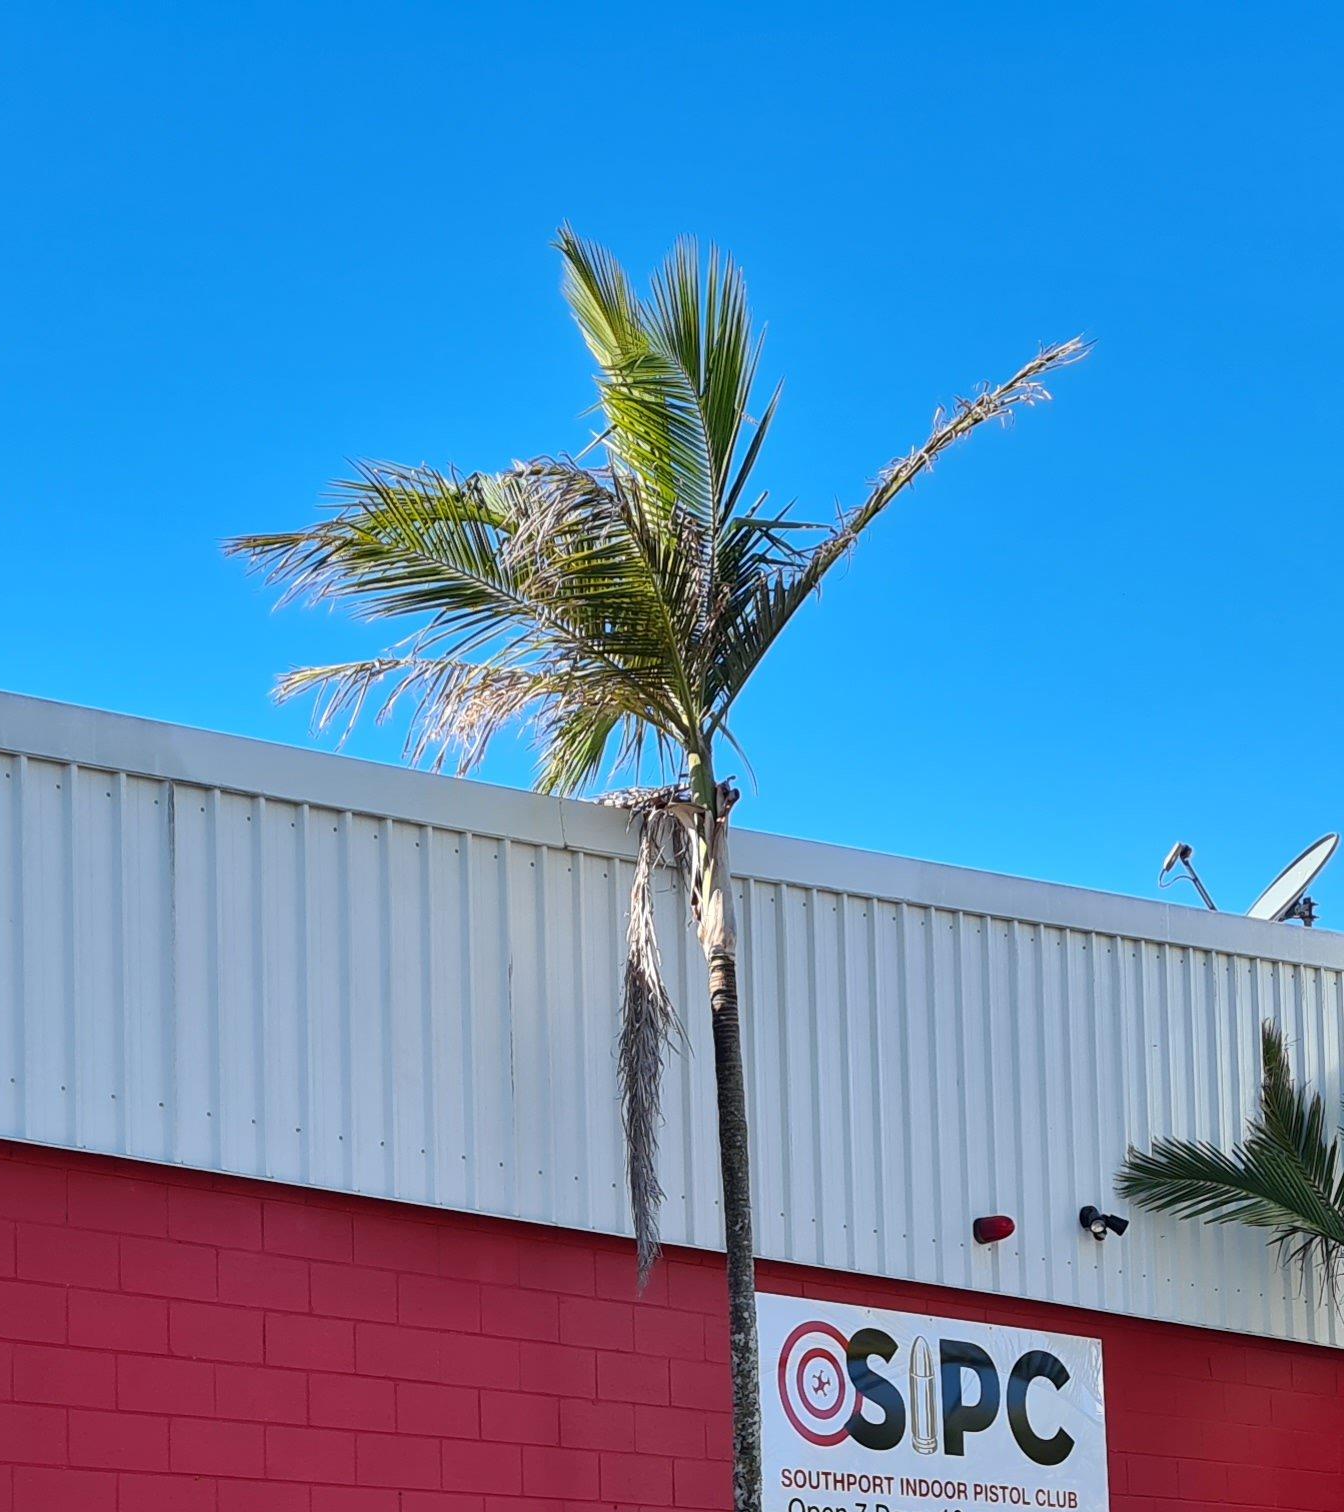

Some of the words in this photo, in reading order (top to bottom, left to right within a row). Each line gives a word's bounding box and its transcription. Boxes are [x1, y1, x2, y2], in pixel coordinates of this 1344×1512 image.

[781, 1469, 894, 1495] SOUTHPORT
[900, 1478, 968, 1500] INDOOR
[973, 1484, 1031, 1505] PISTOL
[1035, 1489, 1078, 1509] CLUB
